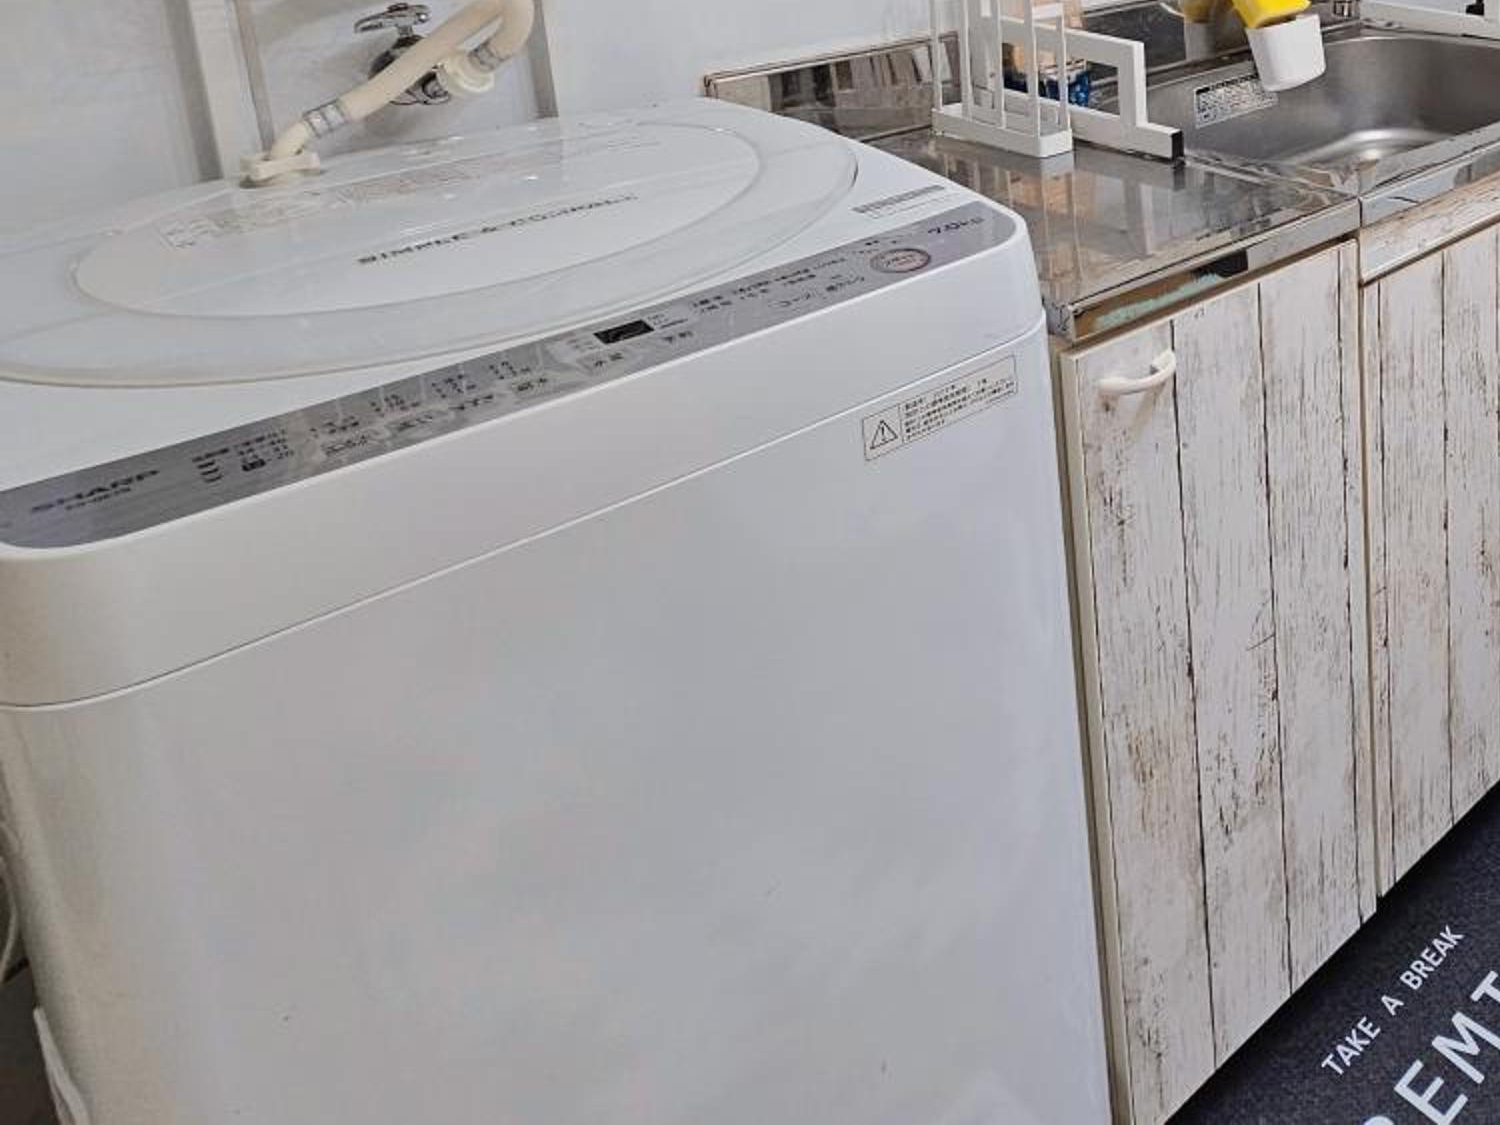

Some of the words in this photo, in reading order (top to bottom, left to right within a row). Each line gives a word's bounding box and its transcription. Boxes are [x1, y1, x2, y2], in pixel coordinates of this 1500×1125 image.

[1321, 1016, 1381, 1075] TAKE
[1380, 993, 1404, 1016] A
[1399, 925, 1465, 991] BREAK
